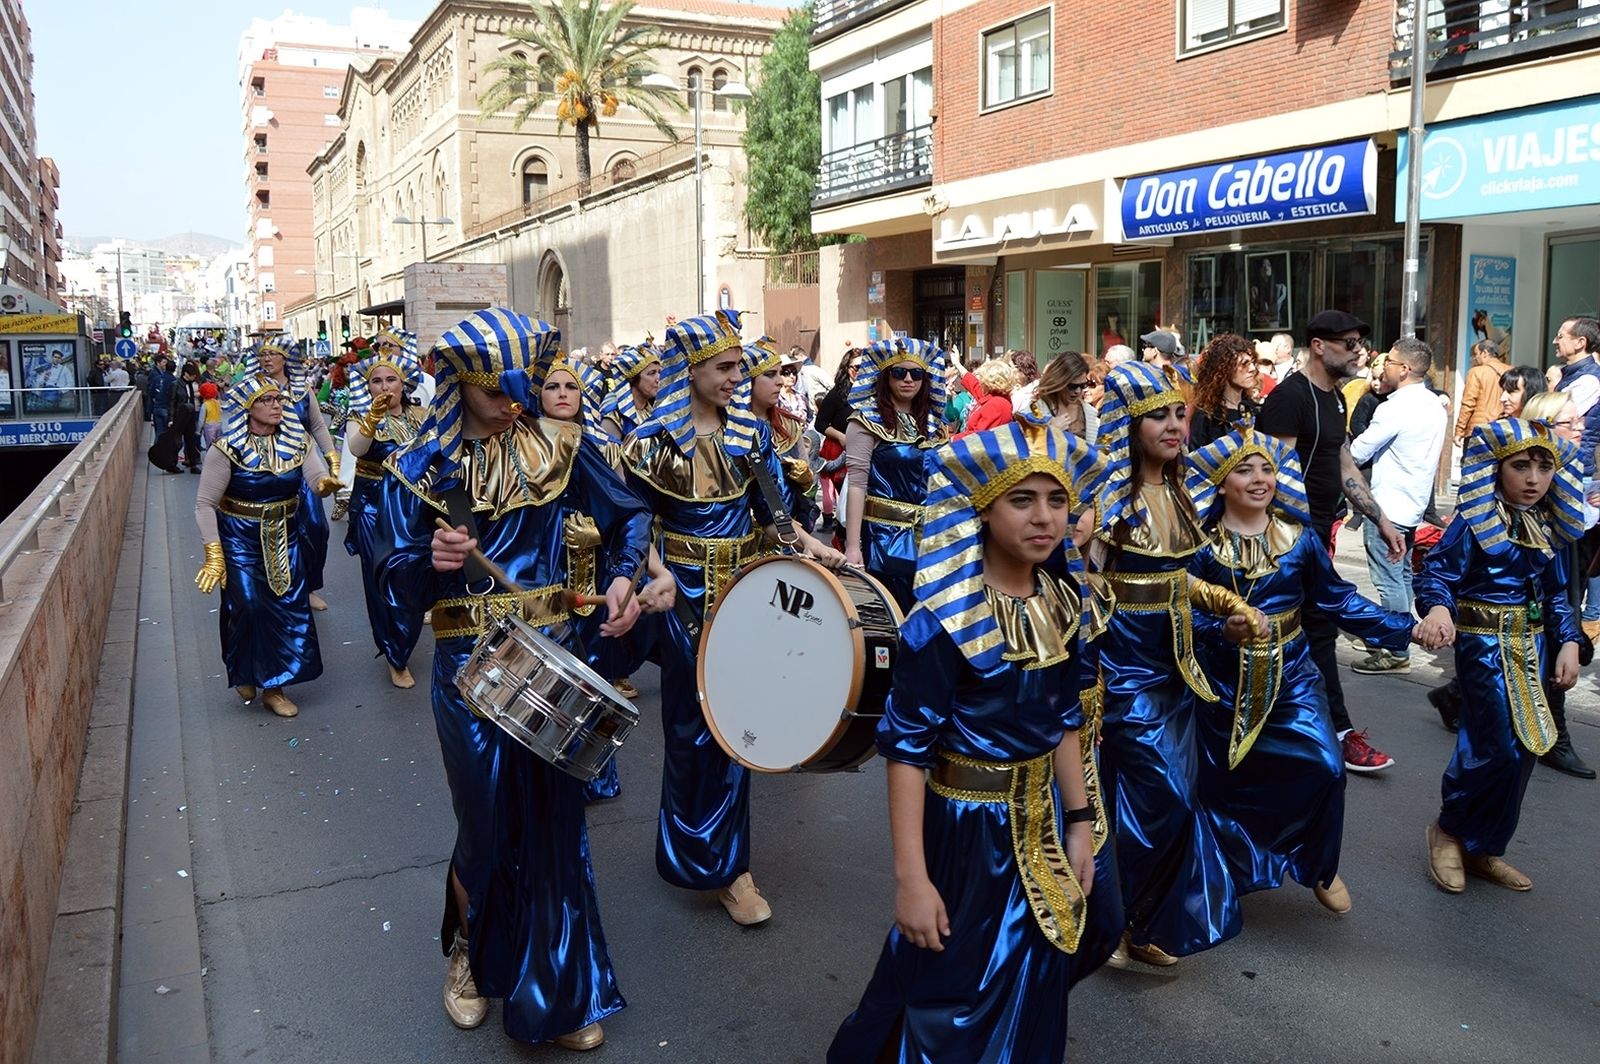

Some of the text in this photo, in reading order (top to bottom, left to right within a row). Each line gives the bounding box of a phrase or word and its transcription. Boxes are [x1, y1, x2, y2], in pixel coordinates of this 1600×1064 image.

[1135, 150, 1346, 220] Don Cabello
[1480, 174, 1579, 196] clickviaja.com
[941, 215, 987, 241] LA
[1138, 220, 1189, 236] ARTICULOS
[1204, 210, 1271, 227] PELUQUERIA
[1291, 201, 1348, 218] ESTETICA
[30, 422, 62, 433] SOLO
[769, 578, 814, 619] NP
